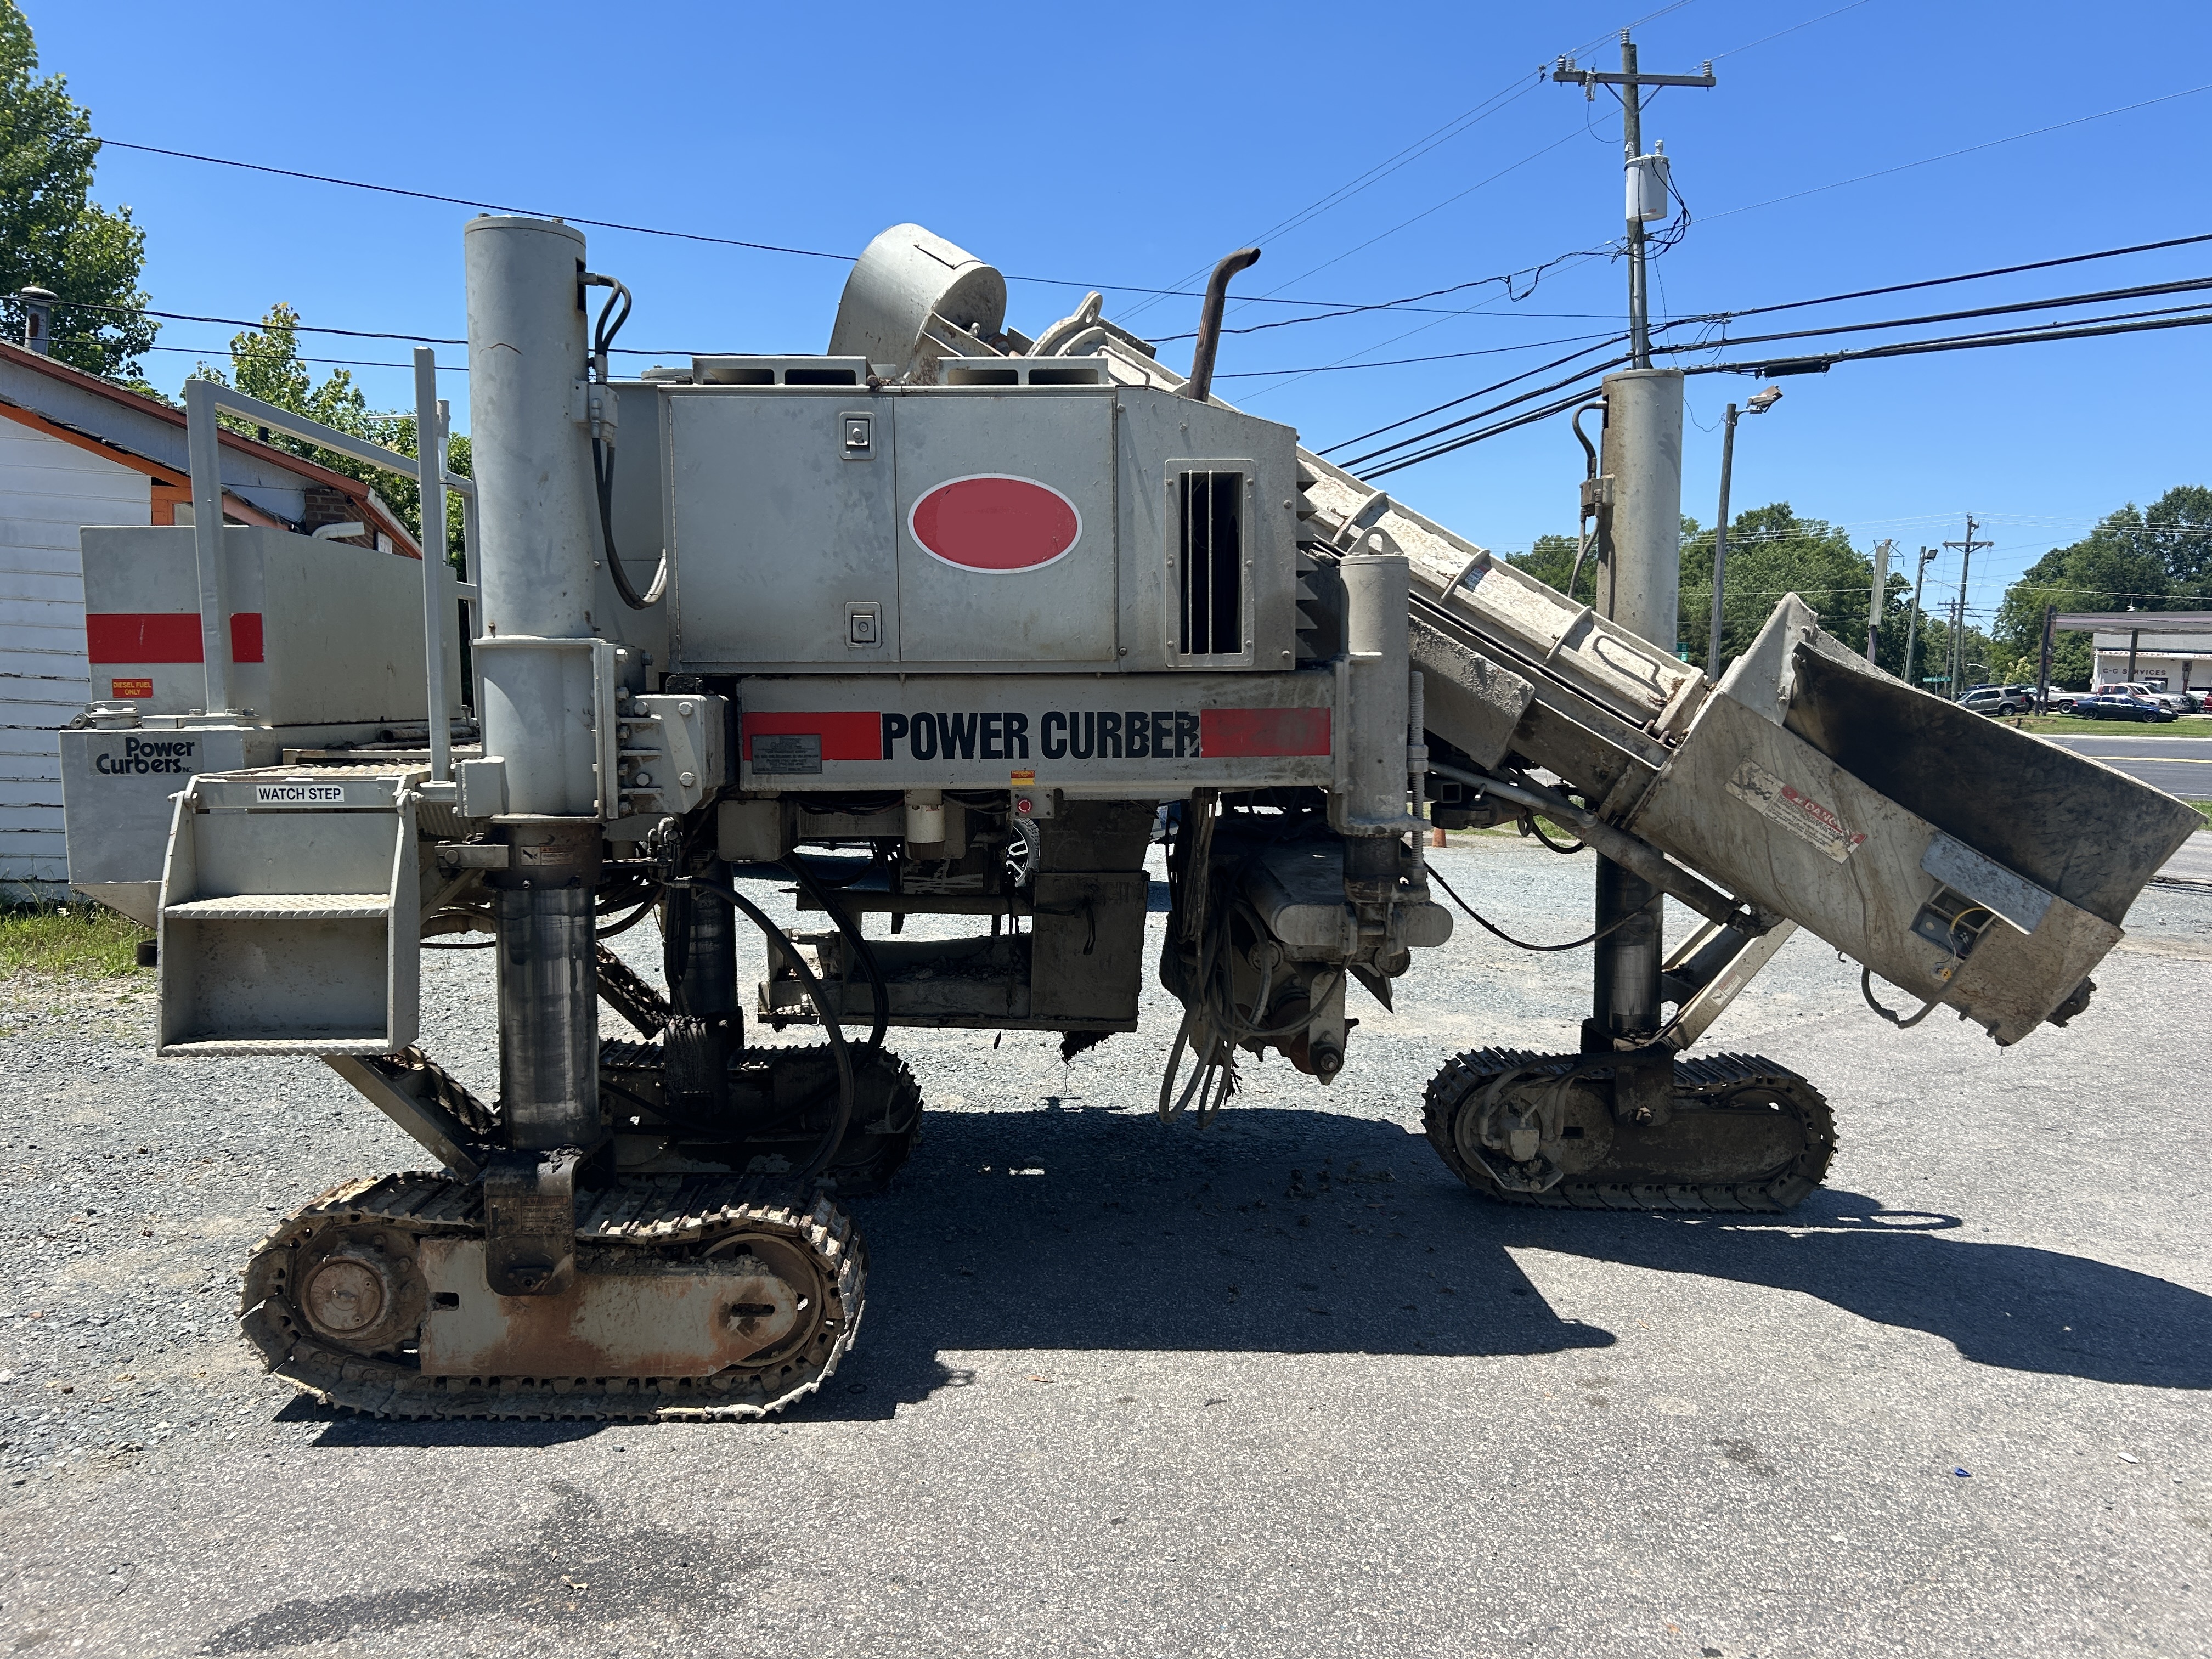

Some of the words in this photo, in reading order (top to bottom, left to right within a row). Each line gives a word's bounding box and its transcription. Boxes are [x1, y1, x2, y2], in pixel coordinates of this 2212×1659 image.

[882, 712, 1029, 761] POWER
[1041, 710, 1200, 760] CURBER
[125, 737, 195, 757] Power
[96, 753, 182, 774] Curbers
[258, 788, 305, 800] WATCH
[308, 788, 341, 800] STEP
[1804, 802, 1854, 836] DANG
